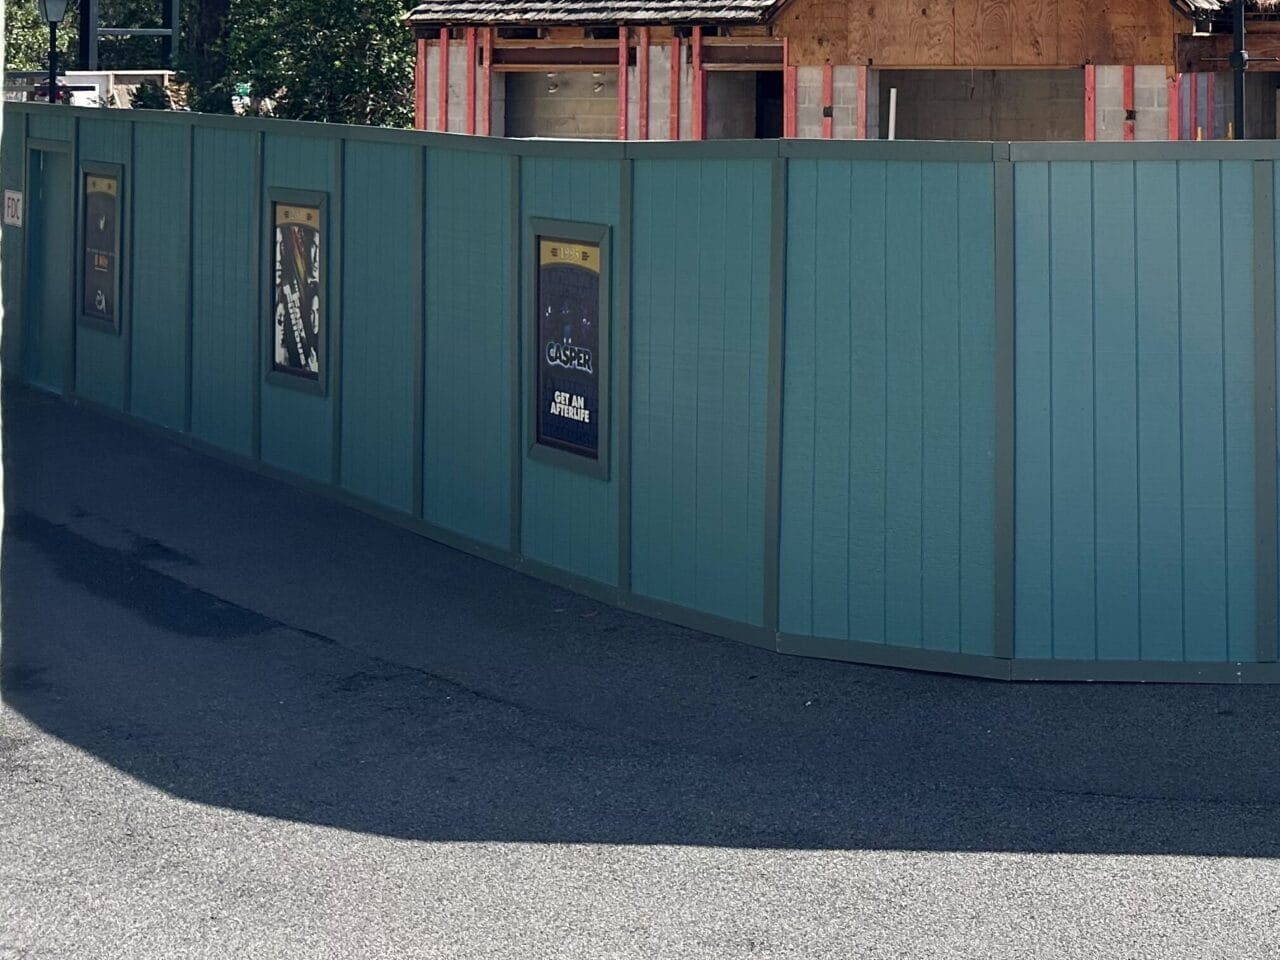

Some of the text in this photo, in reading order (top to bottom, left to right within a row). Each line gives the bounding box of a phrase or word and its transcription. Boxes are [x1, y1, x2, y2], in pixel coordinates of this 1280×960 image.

[7, 197, 20, 220] FDC
[546, 341, 593, 374] CASPER
[554, 391, 584, 409] GET AN
[549, 401, 590, 423] AFTERLIFE
